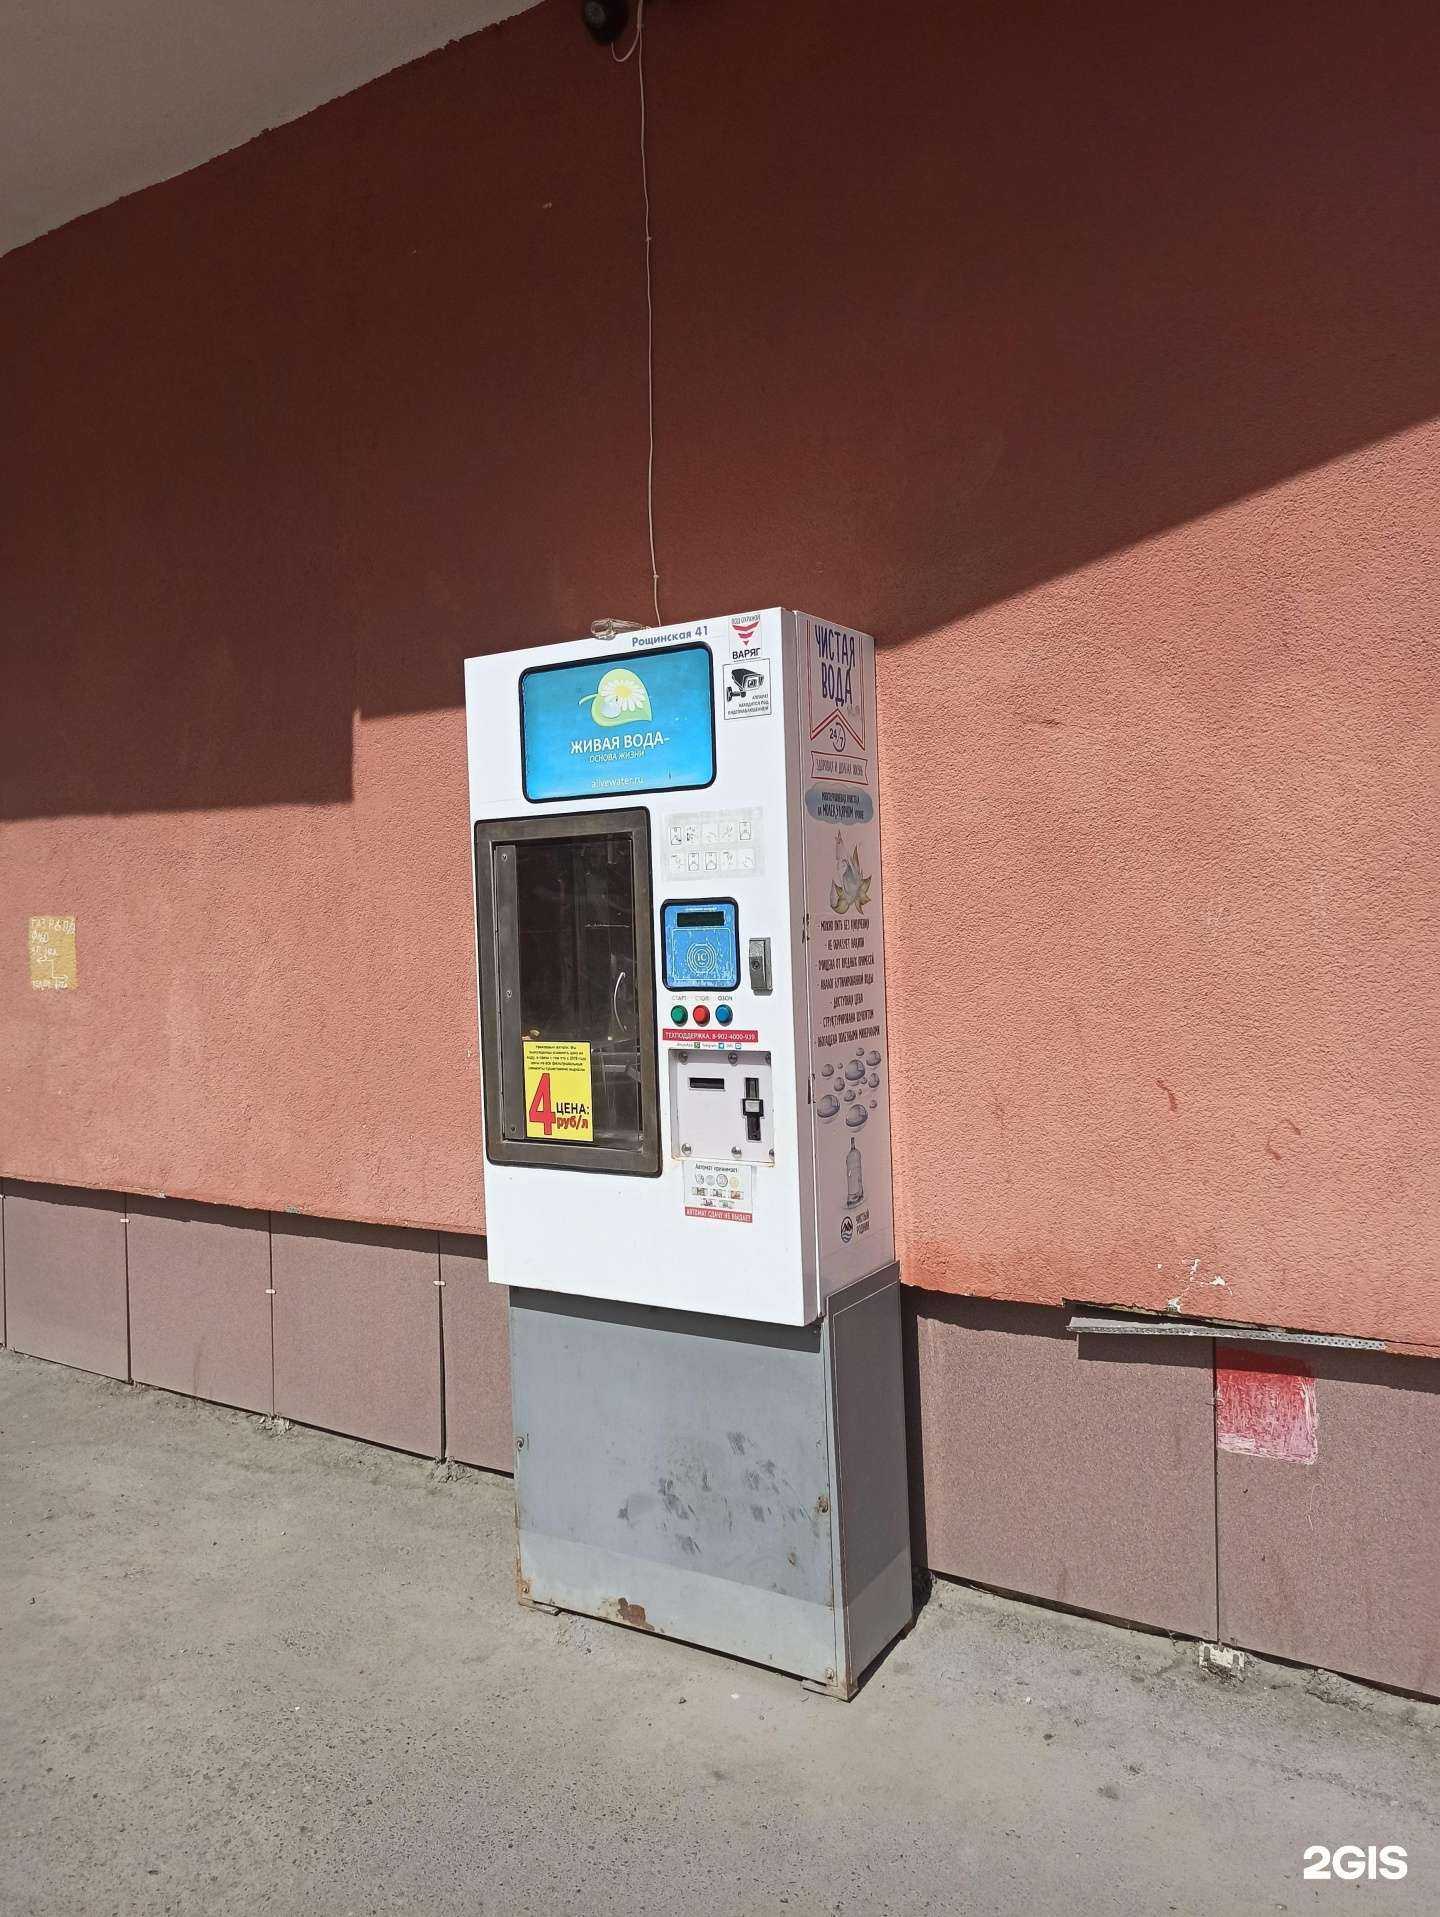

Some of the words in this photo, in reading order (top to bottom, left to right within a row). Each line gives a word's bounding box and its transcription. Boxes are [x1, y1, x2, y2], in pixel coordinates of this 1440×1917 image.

[631, 629, 692, 647] Рощинская
[695, 625, 709, 637] 41
[815, 624, 856, 667] ЧИСТАЯ
[732, 647, 761, 660] ВАРЯГ
[821, 662, 853, 707] ВОДА
[570, 735, 620, 754] ЖИВАЯ
[829, 727, 844, 748] 24/7
[589, 753, 617, 763] ОСНОВА
[618, 750, 645, 761] ЖИЗНИ
[591, 776, 645, 788] alivewater.ru
[528, 1072, 557, 1136] 4
[556, 1101, 590, 1116] ЦЕНА:
[556, 1115, 589, 1130] руб/л
